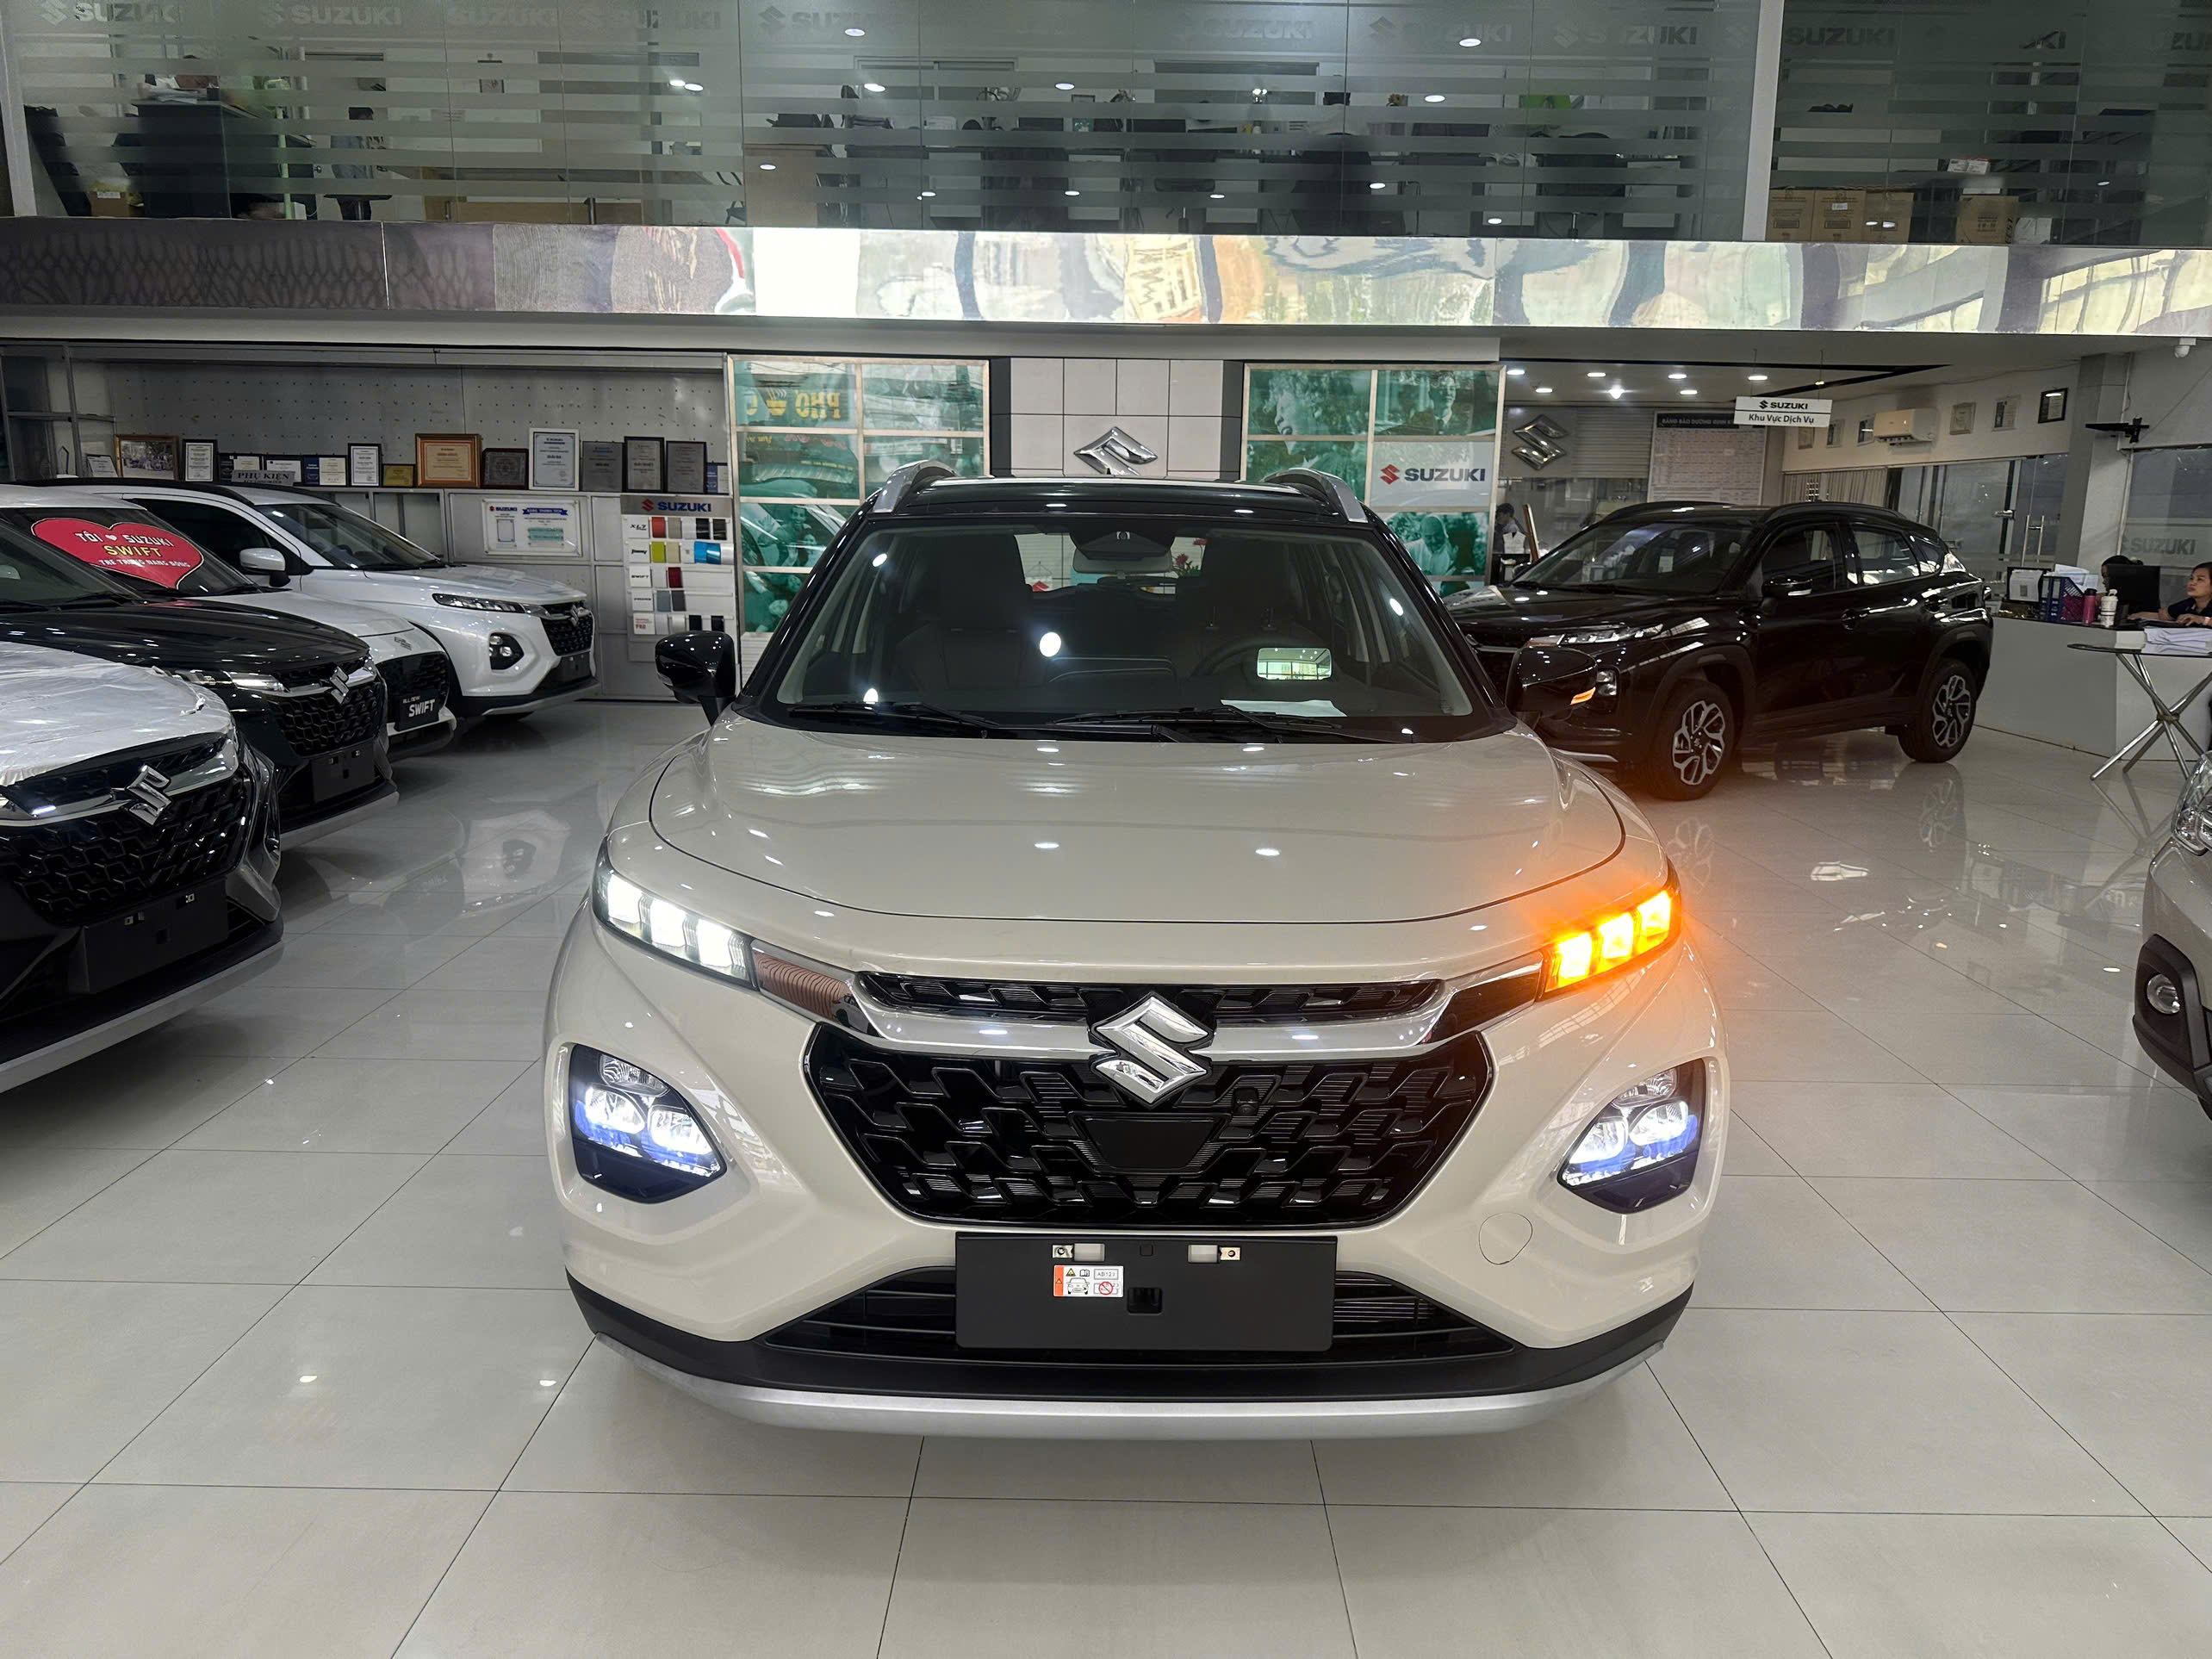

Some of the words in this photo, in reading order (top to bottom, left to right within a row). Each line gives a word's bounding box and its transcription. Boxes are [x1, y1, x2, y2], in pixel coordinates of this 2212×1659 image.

[289, 5, 402, 26] SUZUKI
[1784, 27, 1892, 47] SUZUKI
[1770, 401, 1808, 410] SUZUKI
[1767, 414, 1782, 424] Vực
[1783, 415, 1801, 424] Dịch
[1803, 416, 1814, 425] Vụ
[1404, 468, 1485, 482] SUZUKI
[657, 501, 711, 513] SUZUKI
[75, 530, 103, 543] TÔI
[122, 534, 174, 547] SUZUKI
[2131, 537, 2196, 555] SUZUKI
[103, 544, 162, 557] SWIFT
[408, 699, 435, 718] SWIFT
